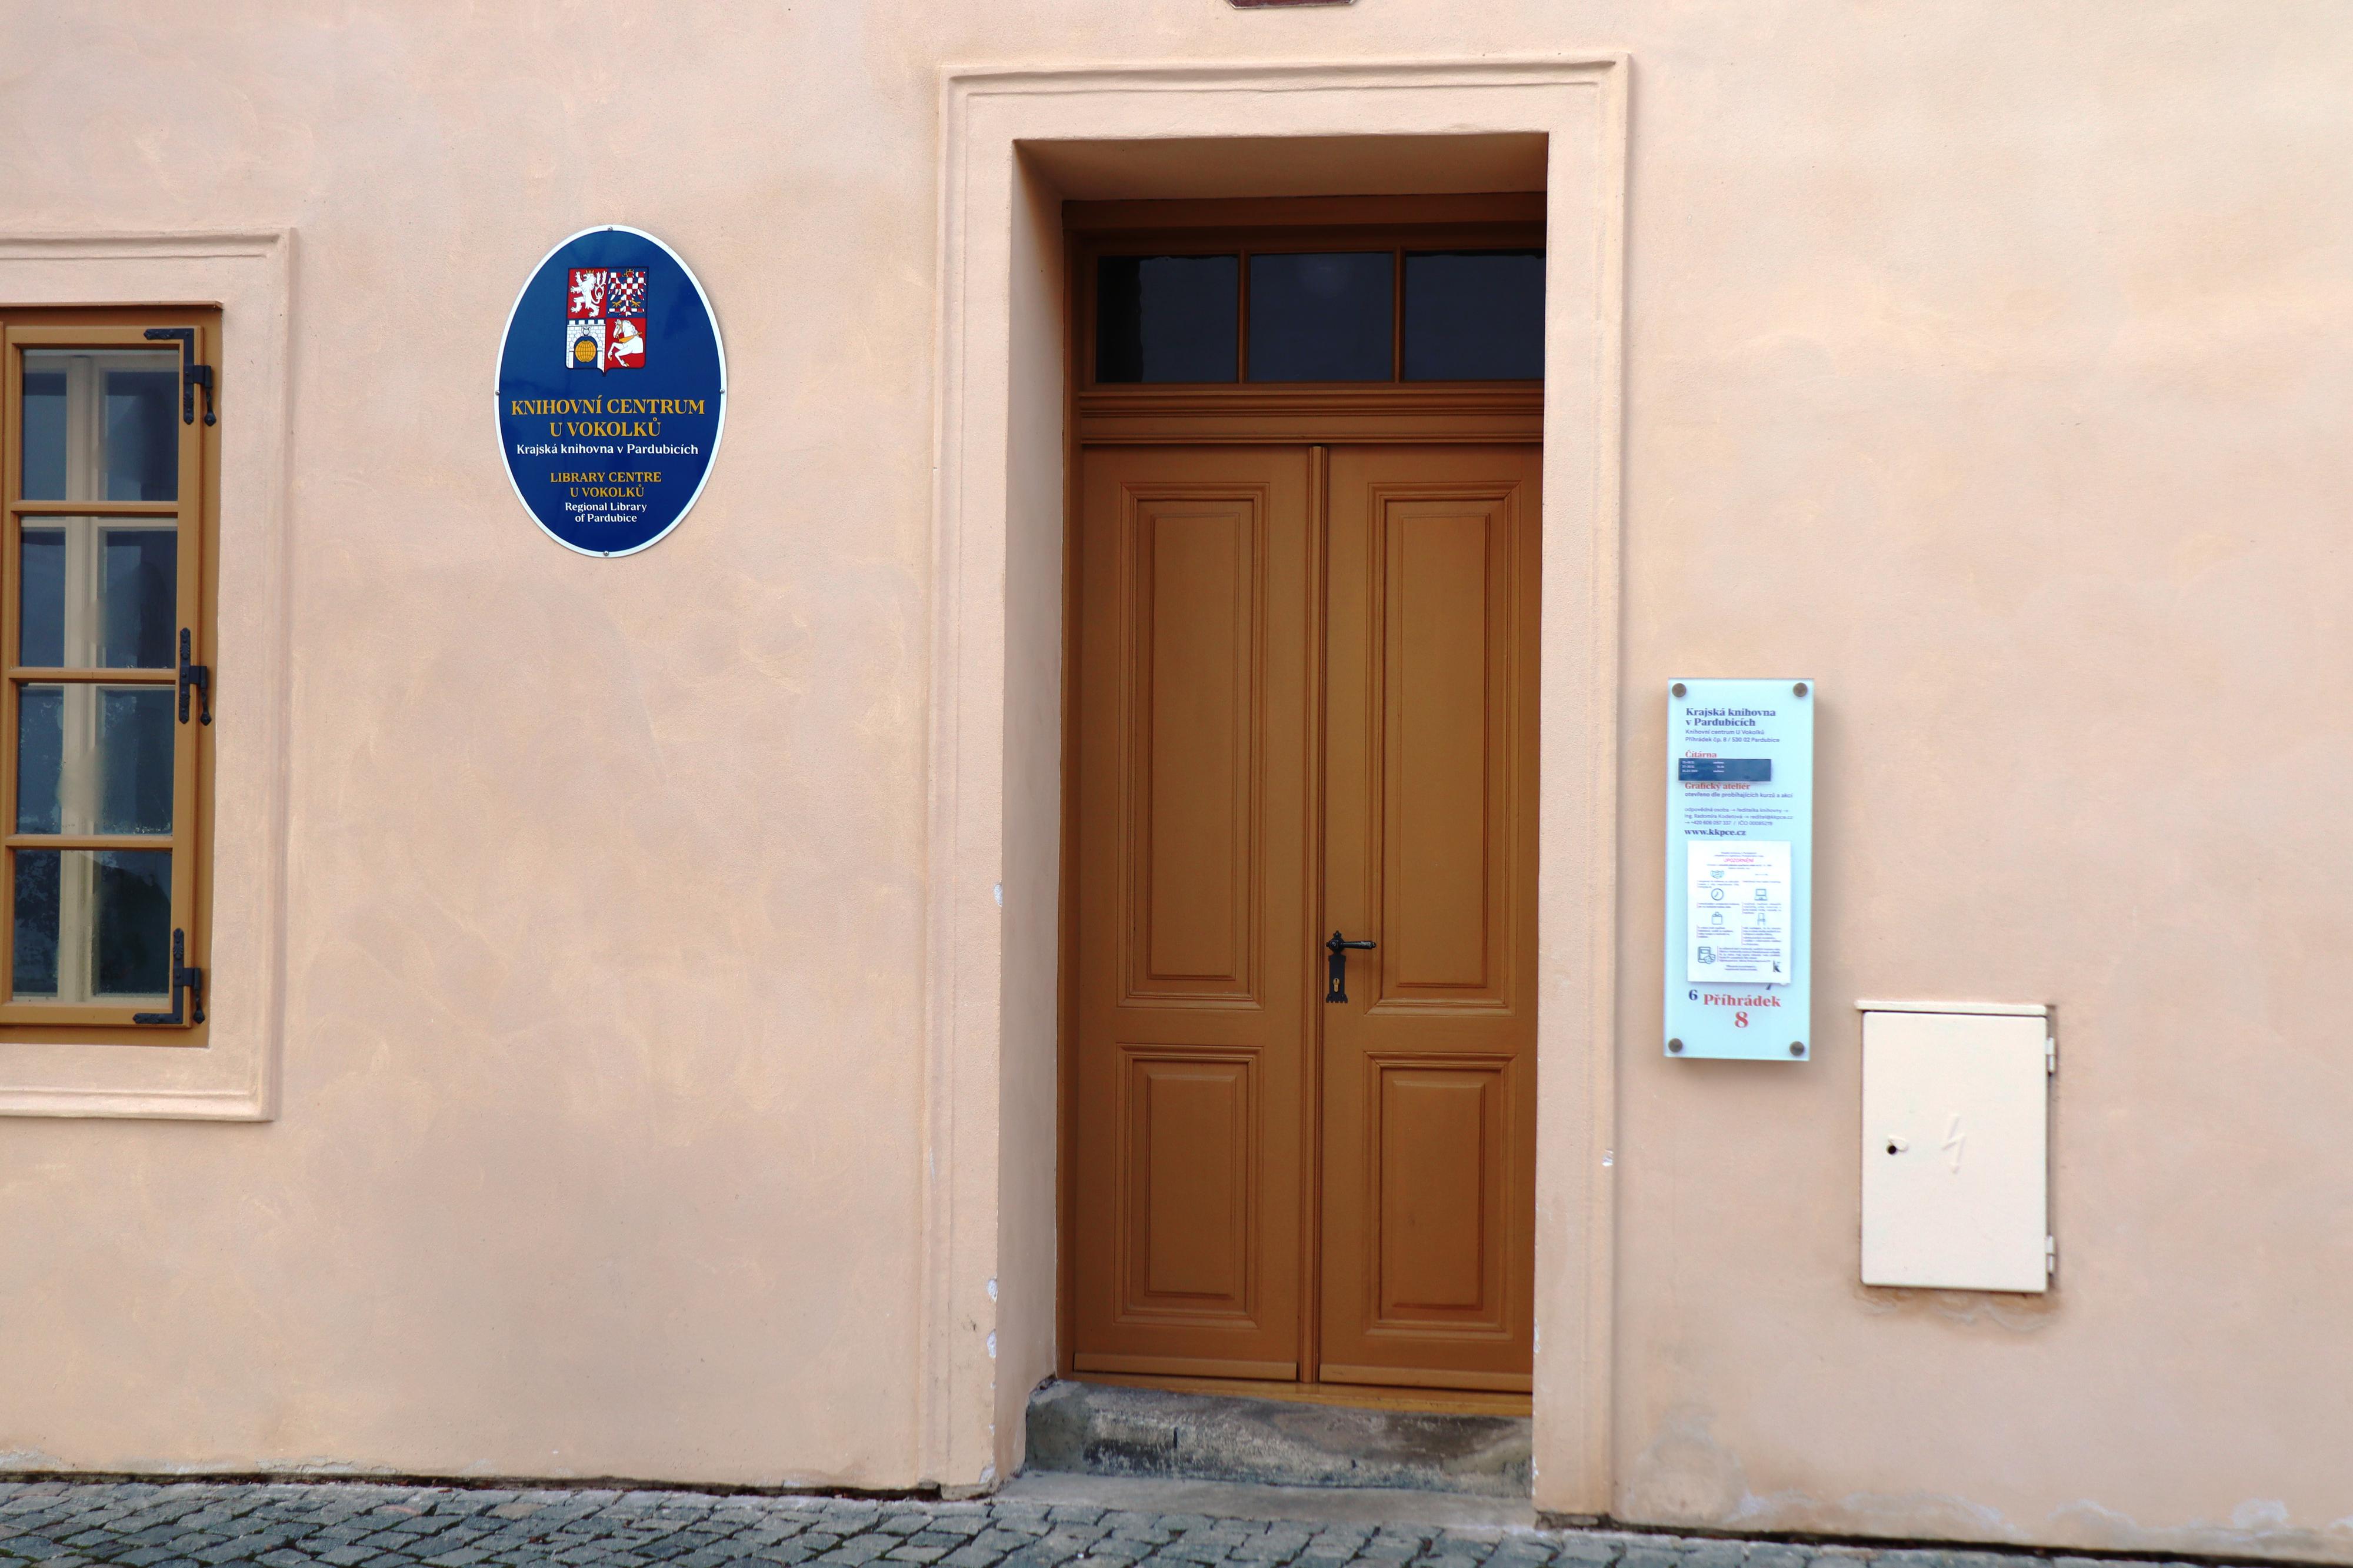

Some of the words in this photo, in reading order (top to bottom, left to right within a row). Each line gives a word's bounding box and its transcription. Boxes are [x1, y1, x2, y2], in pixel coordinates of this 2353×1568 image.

[511, 395, 602, 415] KNIHOVNÍ
[606, 399, 705, 415] CENTRUM
[549, 422, 562, 437] U
[566, 417, 661, 437] VOKOLKŮ
[516, 443, 558, 457] Krajská
[561, 443, 614, 455] knihovna
[616, 446, 624, 455] v
[626, 444, 699, 455] Pardubicích
[550, 472, 606, 483] LIBRARY
[608, 472, 662, 483] CENTRE
[569, 487, 579, 498] U
[581, 484, 645, 498] VOKOLKŮ
[565, 502, 608, 513] Regional
[610, 502, 647, 513] Library
[575, 513, 585, 522] of
[587, 513, 637, 522] Pardubice
[1686, 708, 1725, 718] Krajská
[1728, 708, 1776, 716] knihovna
[1694, 718, 1756, 726] Pardubicích
[1685, 782, 1721, 790] Grafický
[1685, 828, 1747, 837] www.kkpce.cz
[1688, 989, 1698, 1000] 6
[1703, 993, 1781, 1007] Příhrádek
[1734, 1011, 1749, 1028] 8
